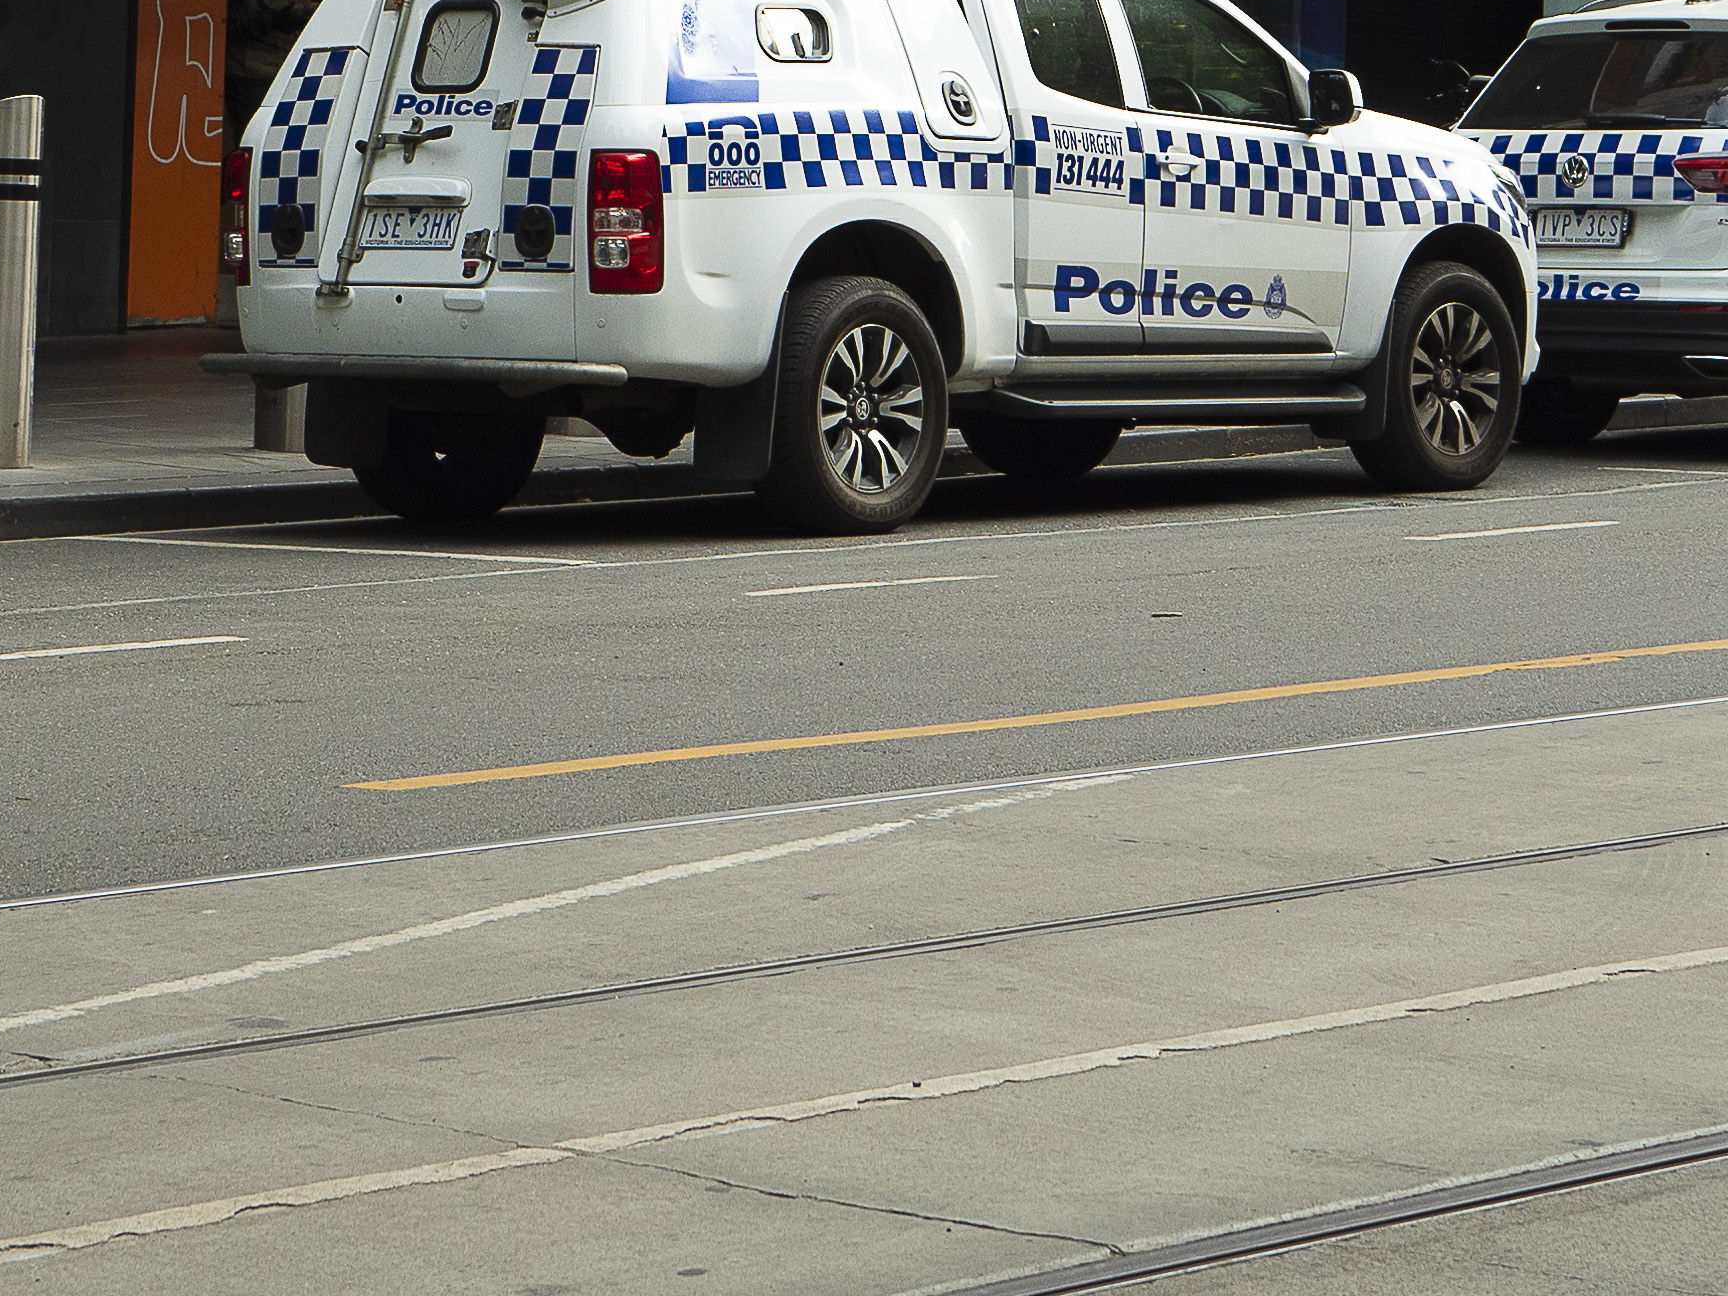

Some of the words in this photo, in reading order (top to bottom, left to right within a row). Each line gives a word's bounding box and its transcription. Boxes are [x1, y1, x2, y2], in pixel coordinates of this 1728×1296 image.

[393, 94, 494, 116] Police
[1053, 128, 1124, 157] NON-URGENT
[708, 169, 762, 187] EMERGENCY
[417, 212, 457, 240] 3HK
[1585, 214, 1620, 237] 3CS
[1054, 264, 1254, 320] Police
[1537, 273, 1641, 301] olice
